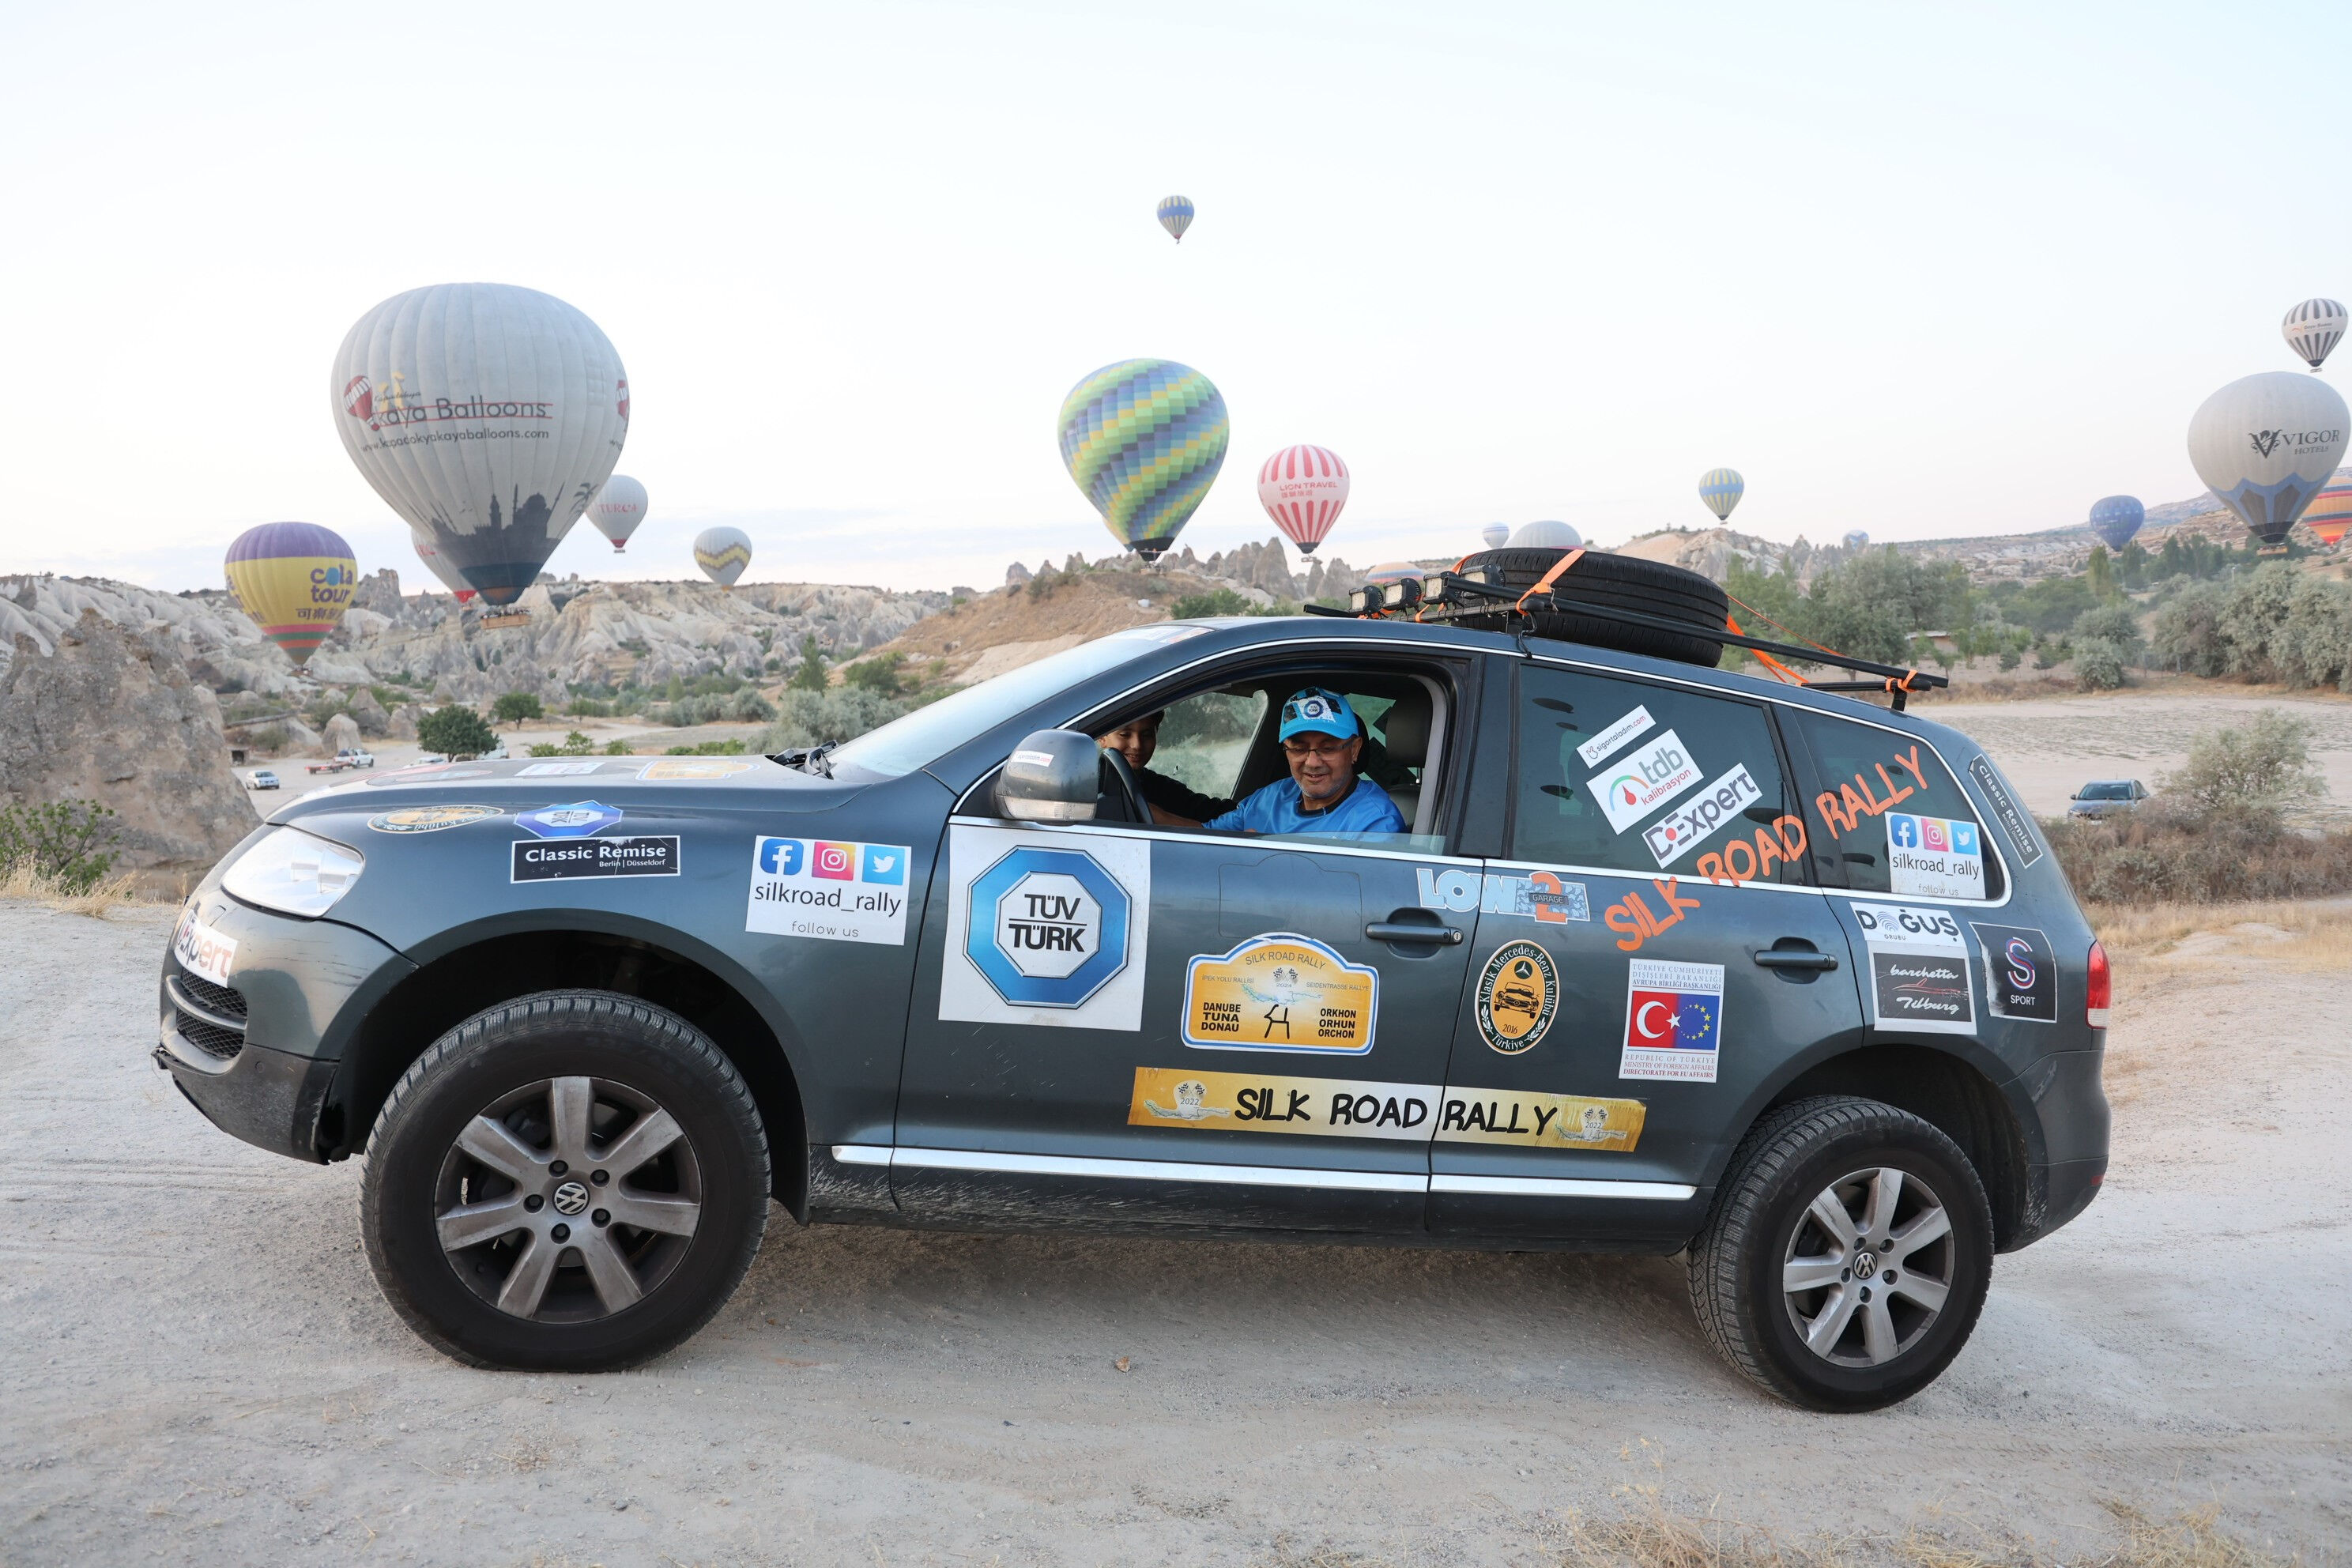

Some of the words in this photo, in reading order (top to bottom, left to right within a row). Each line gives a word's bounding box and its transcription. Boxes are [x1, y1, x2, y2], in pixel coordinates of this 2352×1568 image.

[435, 394, 546, 420] Balloons
[2282, 429, 2340, 446] VIGOR
[2294, 445, 2329, 454] HOTELS
[310, 564, 353, 586] cola
[310, 586, 351, 603] tour
[1596, 714, 1646, 752] sigortaladim.com
[1638, 747, 1684, 785] tdb
[1641, 768, 1692, 805] kalibrasyon
[1978, 764, 2007, 808] Classic
[2005, 808, 2033, 854] Remise
[525, 846, 593, 862] Classic
[598, 843, 666, 859] Remise
[1604, 876, 1701, 952] SILK
[1696, 815, 1807, 888] ROAD
[1815, 745, 1928, 840] RALLY
[627, 858, 665, 867] Düsseldorf
[1892, 853, 1979, 880] silkroad_rally
[1415, 868, 1517, 914] LOW
[1918, 883, 1946, 895] follow
[754, 881, 901, 918] silkroad_rally
[1024, 893, 1081, 921] TÜV
[1532, 894, 1564, 903] GARAGE
[792, 921, 837, 936] follow
[842, 927, 859, 938] us
[1008, 923, 1086, 952] TÜRK
[1245, 952, 1265, 966] SILK
[1268, 951, 1295, 962] ROAD
[1298, 955, 1326, 971] RALLY
[1479, 971, 1497, 1004] Klasik
[1491, 944, 1552, 978] Mercedes-Benz
[1542, 980, 1555, 1016] Kulübü
[1890, 963, 1960, 981] barchetta
[1306, 982, 1348, 990] SEIDENTRASSE
[1203, 1001, 1241, 1013] DANUBE
[1896, 996, 1960, 1015] Tilburg
[2010, 994, 2036, 1006] SPORT
[1202, 1012, 1239, 1023] TUNA
[1320, 1008, 1356, 1019] ORKHON
[1200, 1022, 1239, 1032] DONAU
[1319, 1019, 1355, 1029] ORHUN
[1502, 1023, 1518, 1035] 2016
[1318, 1028, 1355, 1038] ORCHON
[1491, 1034, 1525, 1051] Türkiye
[1625, 1054, 1664, 1062] REPUBLIC
[1234, 1087, 1311, 1122] SILK
[1329, 1093, 1428, 1129] ROAD
[1442, 1099, 1558, 1136] RALLY
